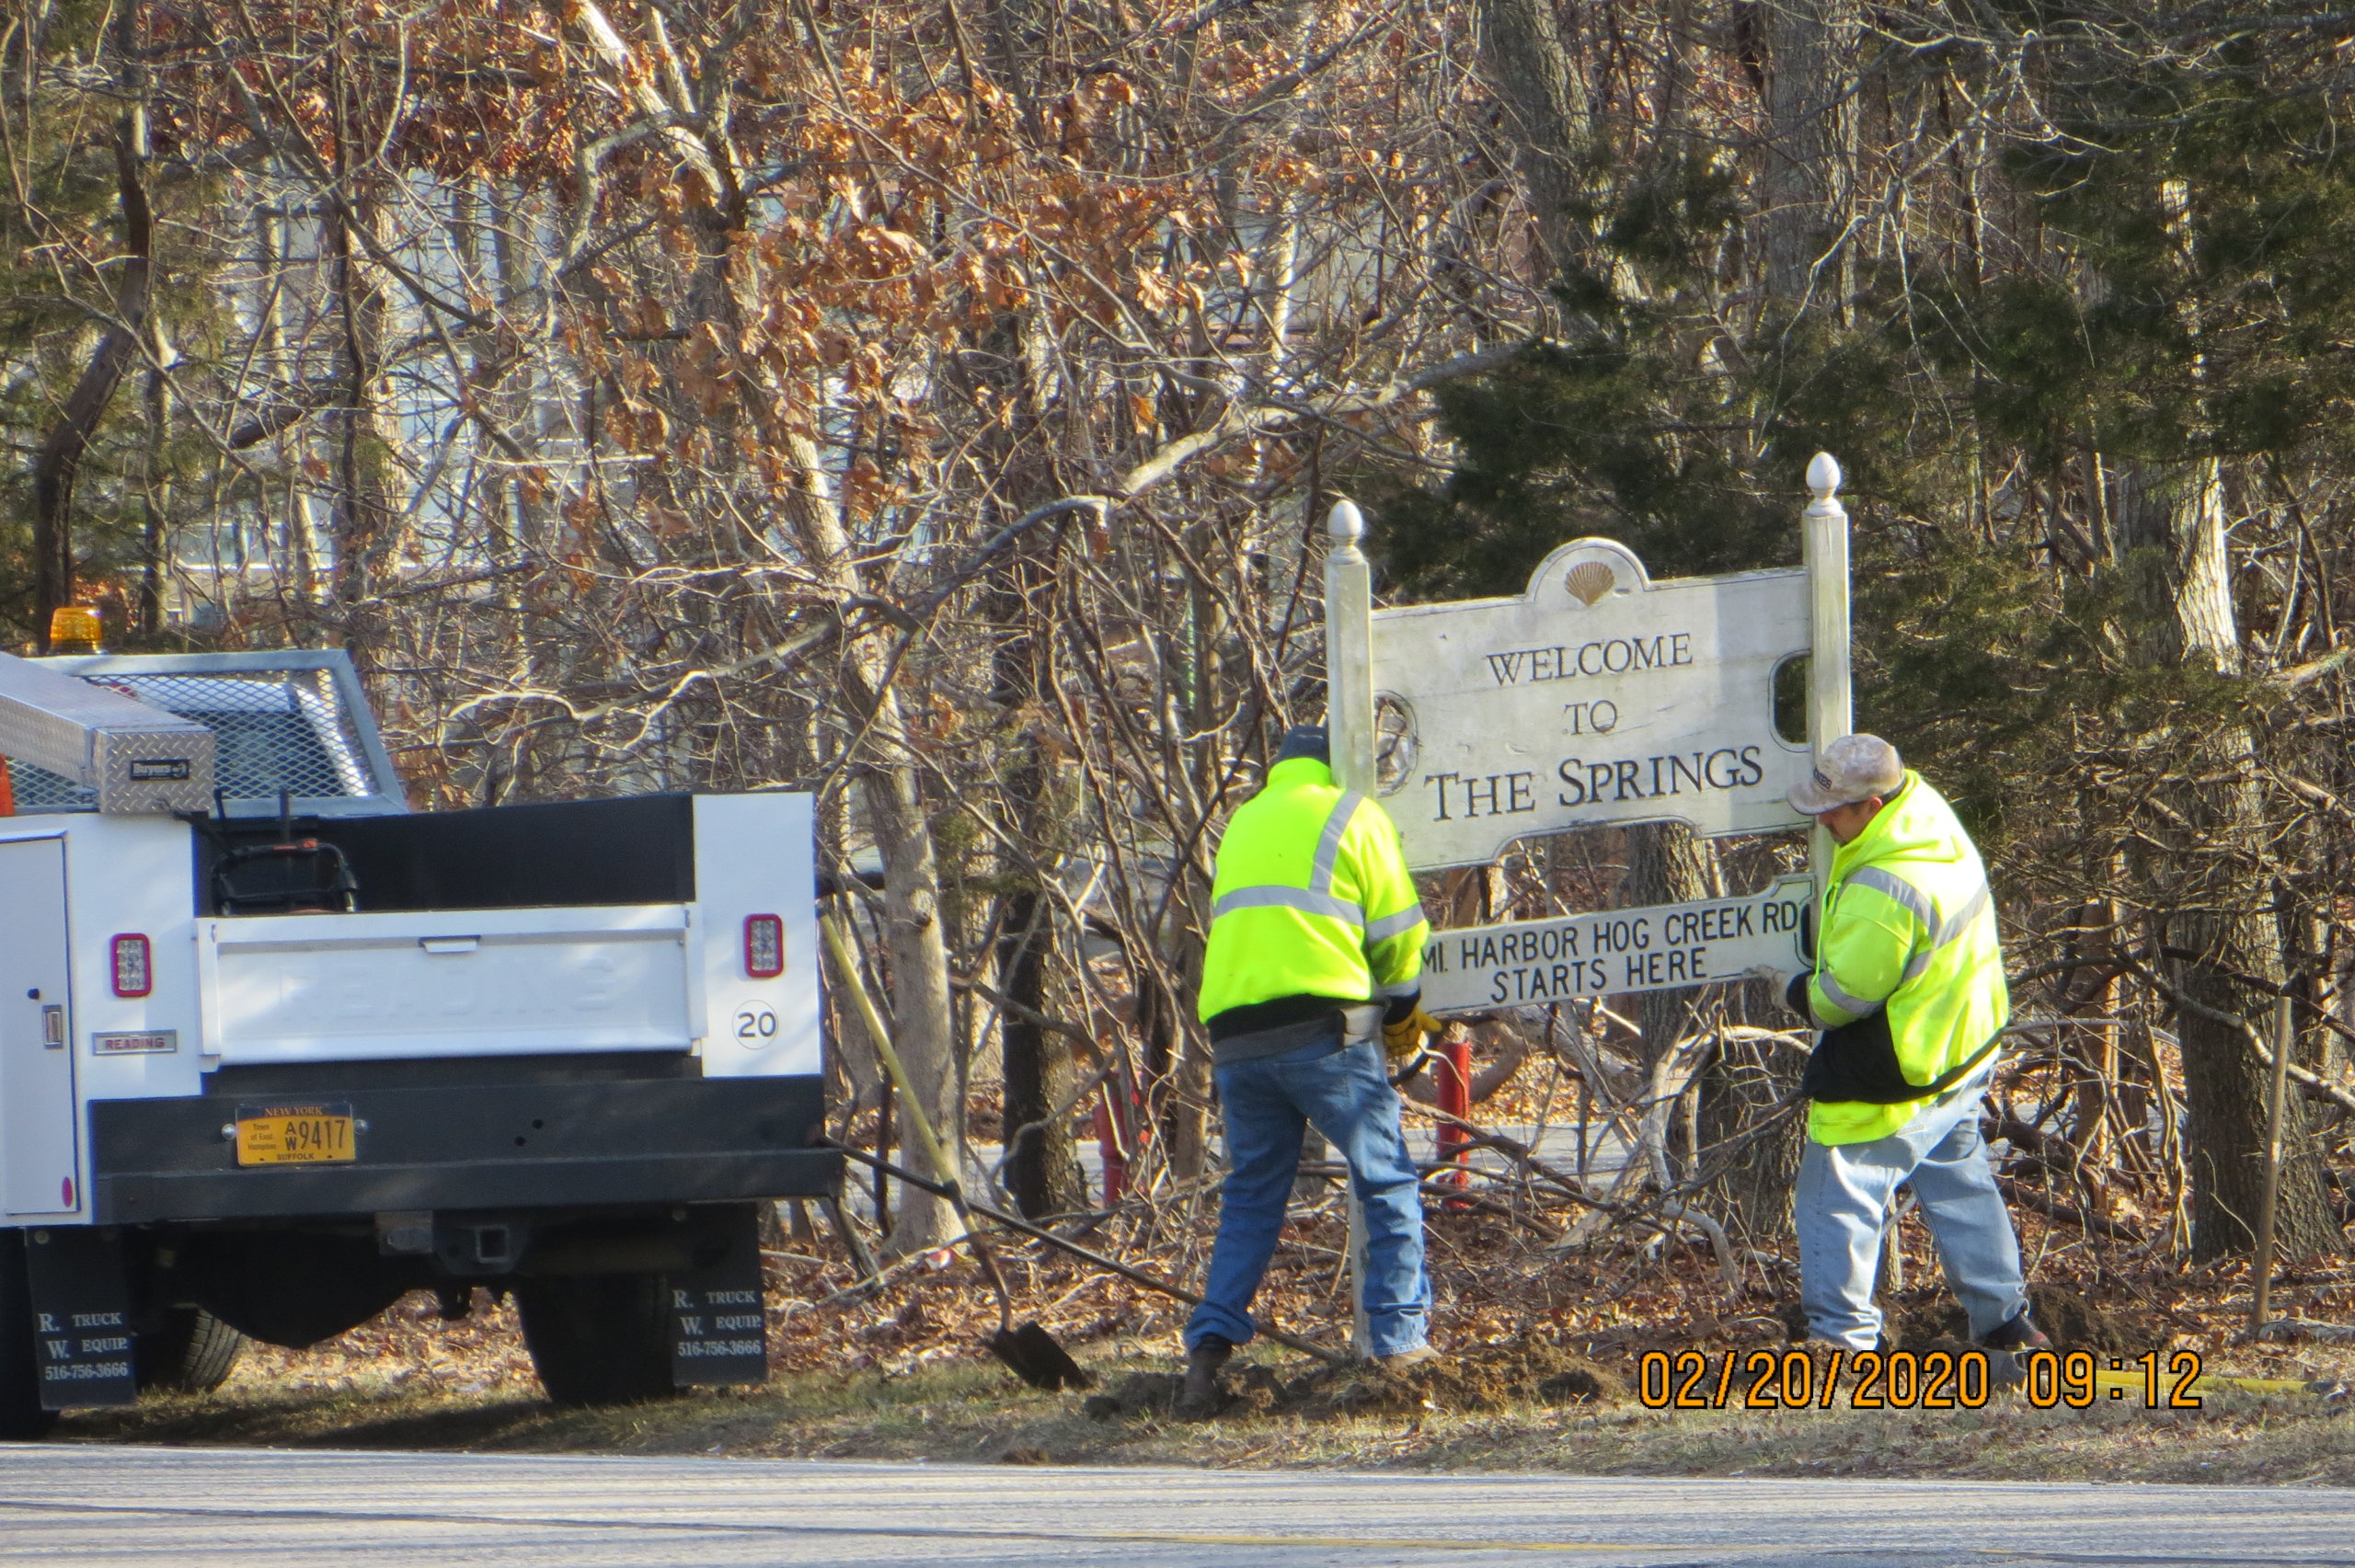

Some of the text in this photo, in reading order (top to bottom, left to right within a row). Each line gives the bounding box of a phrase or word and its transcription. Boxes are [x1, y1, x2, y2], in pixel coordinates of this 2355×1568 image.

[1486, 633, 1694, 687] WELCOME
[1564, 699, 1619, 736] TO
[1423, 771, 1536, 822] THE
[1558, 746, 1765, 807] SPRINGS
[1461, 926, 1579, 969] HARBOR
[1593, 918, 1650, 954] HOG
[1664, 905, 1754, 945] CREEK
[1763, 900, 1798, 934] RD
[1489, 946, 1708, 1003] STARTS HERE
[737, 1011, 776, 1038] 20
[105, 1036, 166, 1050] READING
[264, 1105, 323, 1116] NEW YORK
[277, 1152, 316, 1162] SUFFOLK
[672, 1289, 757, 1309] R. TRUCK
[39, 1312, 122, 1333] R. TRUCK
[680, 1316, 704, 1335] W.
[46, 1340, 71, 1359] W.
[677, 1340, 763, 1357] 516-756-3666
[44, 1361, 129, 1380] 516-756-3666
